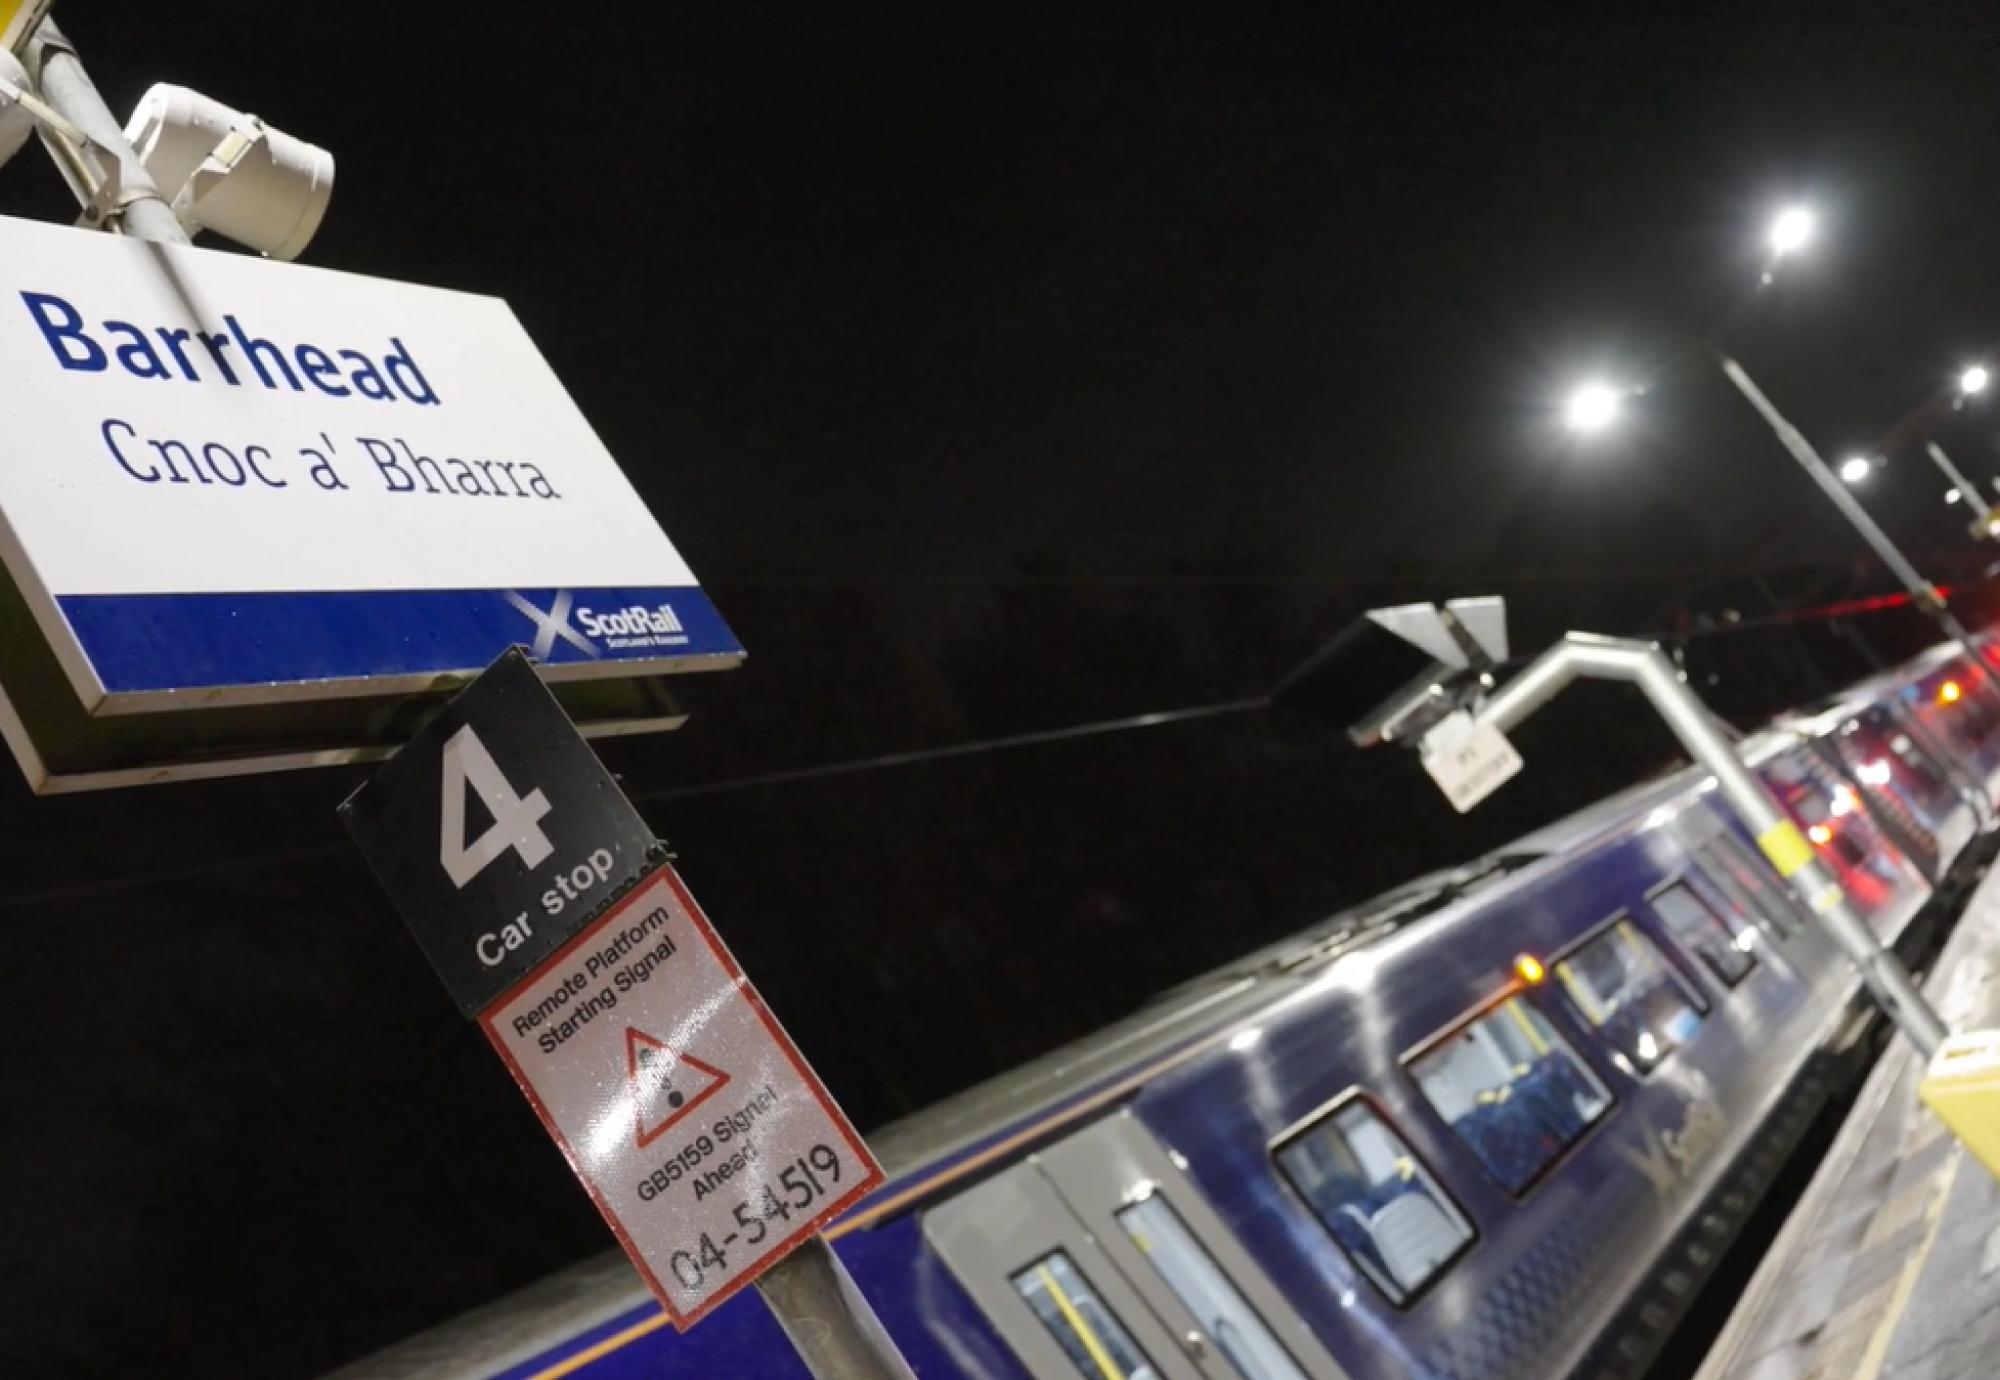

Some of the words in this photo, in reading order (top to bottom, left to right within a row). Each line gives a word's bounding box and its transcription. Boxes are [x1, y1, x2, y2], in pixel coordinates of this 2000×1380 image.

[20, 290, 442, 407] Barrhead
[100, 418, 289, 489] Cnoc
[356, 436, 562, 500] Bharra
[577, 604, 684, 637] ScotRail
[439, 723, 555, 890] 4
[476, 911, 533, 966] Car
[541, 848, 614, 915] stop
[512, 972, 588, 1038] Remote
[585, 906, 670, 978] Platform
[537, 986, 617, 1054] Starting
[613, 934, 678, 992] Signal
[636, 1135, 714, 1201] GB5159
[712, 1084, 779, 1144] Signal
[691, 1139, 760, 1201] Ahead
